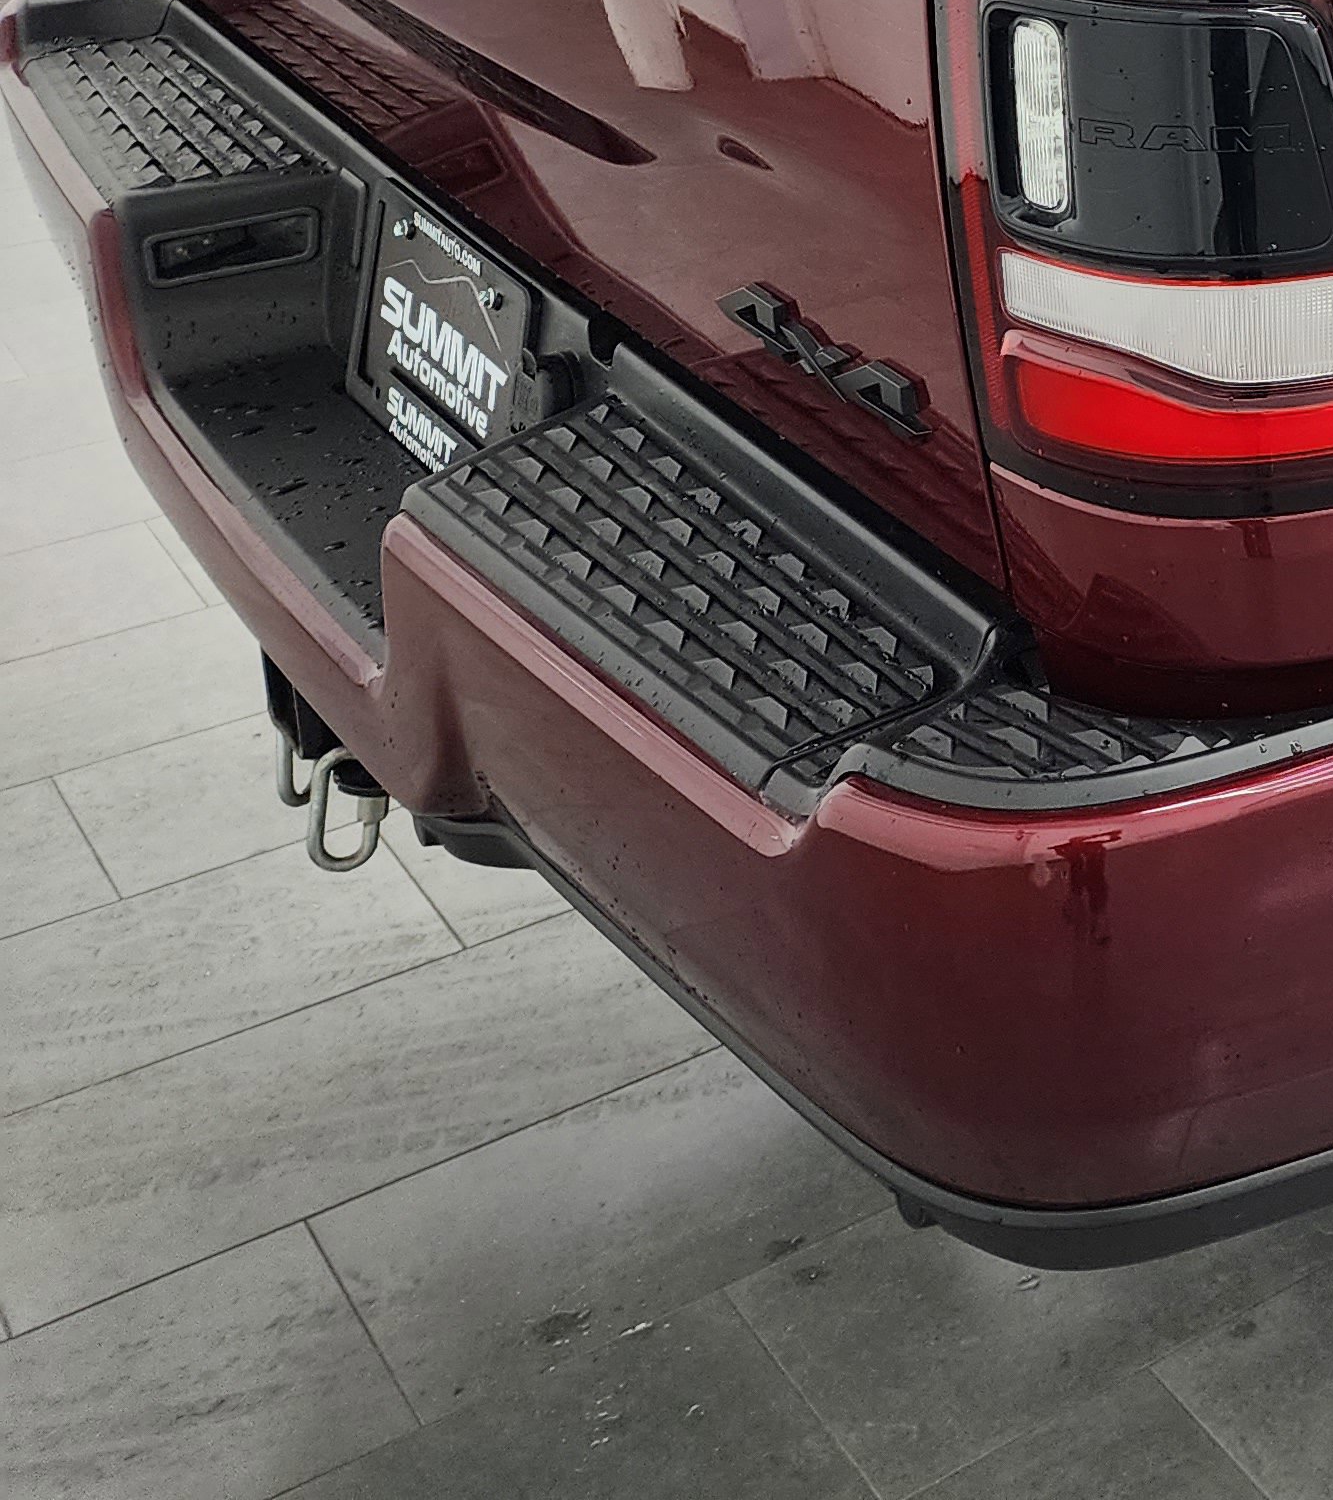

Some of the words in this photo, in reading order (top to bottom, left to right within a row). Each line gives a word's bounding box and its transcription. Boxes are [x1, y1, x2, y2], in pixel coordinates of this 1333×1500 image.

[1078, 117, 1293, 153] RAM
[413, 211, 481, 277] SUMMITAUTO.COM
[380, 276, 509, 412] SUMMIT
[386, 329, 490, 439] Automotive
[386, 386, 460, 464] SUMMIT
